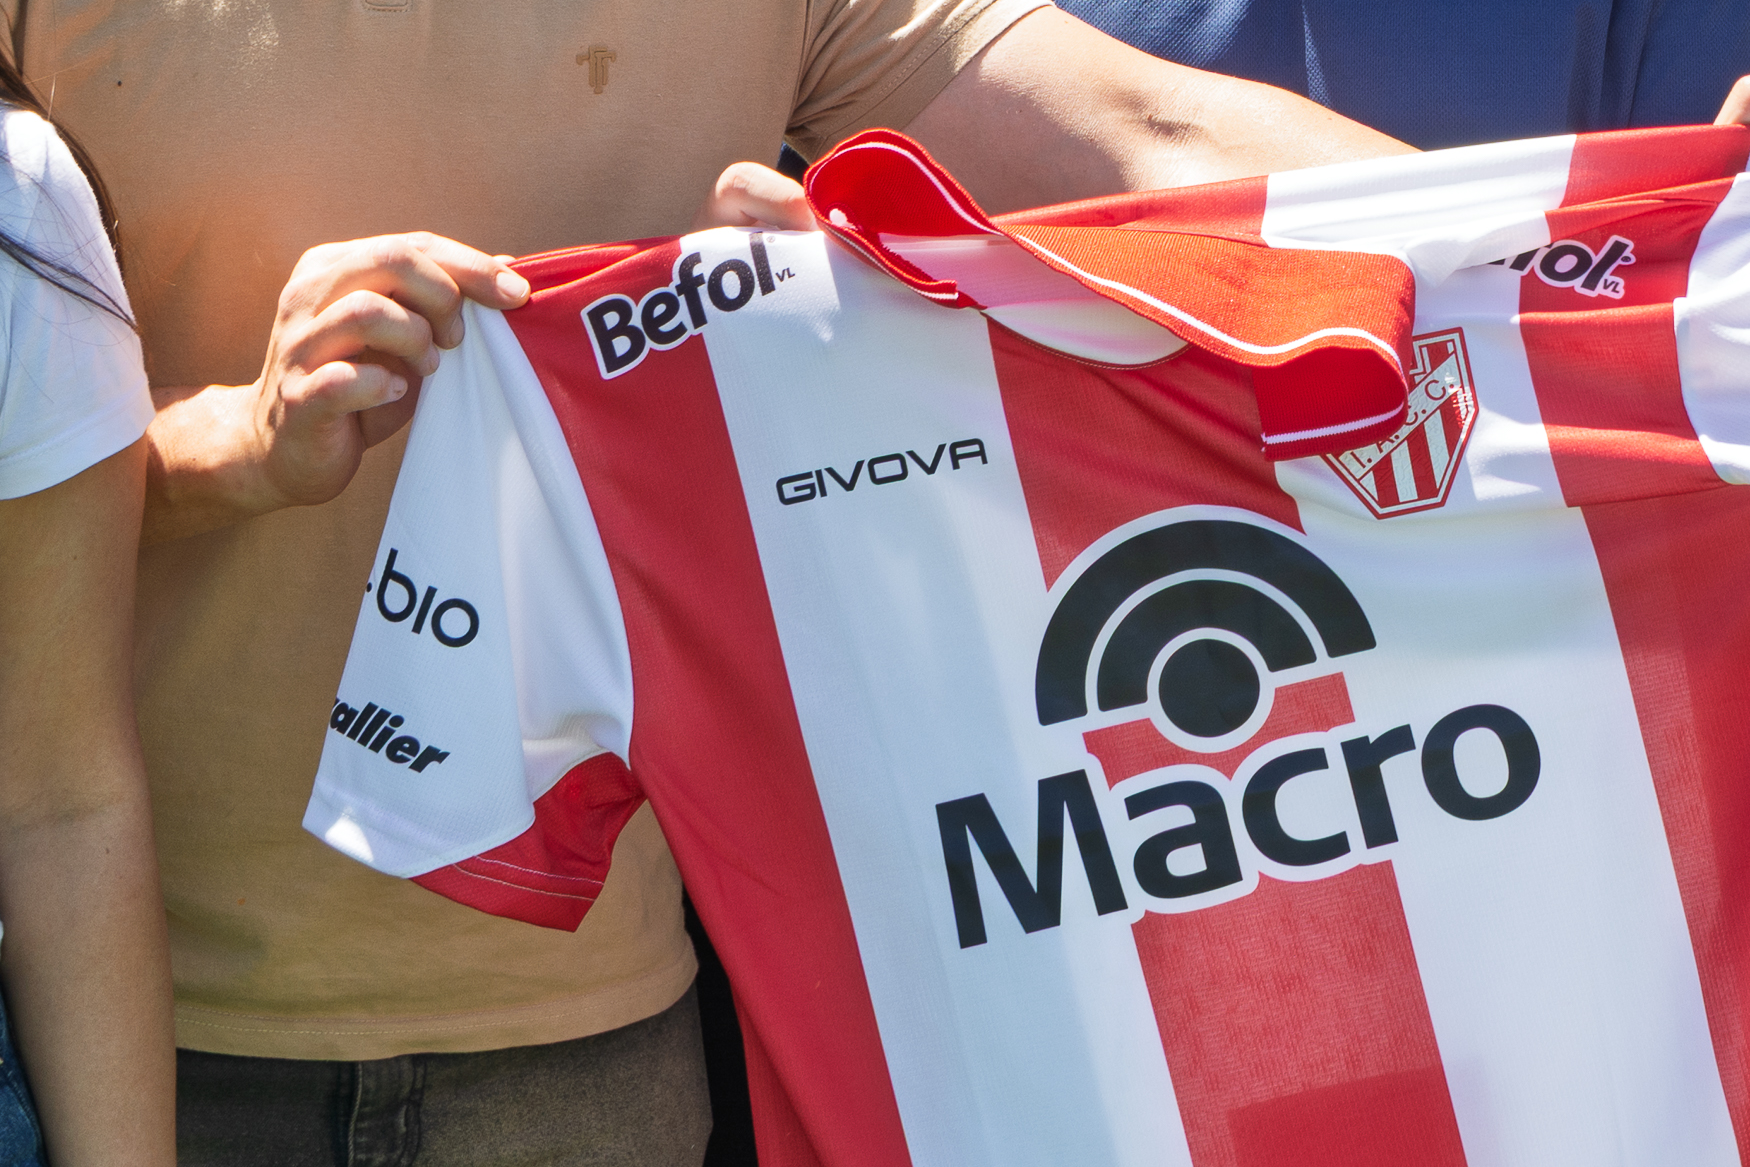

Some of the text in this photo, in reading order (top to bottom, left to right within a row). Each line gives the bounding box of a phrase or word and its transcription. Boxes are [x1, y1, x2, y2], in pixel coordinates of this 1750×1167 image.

[586, 231, 776, 374] Befol
[775, 438, 989, 506] GIVOVA
[330, 697, 451, 774] allier
[935, 703, 1542, 949] Macro
